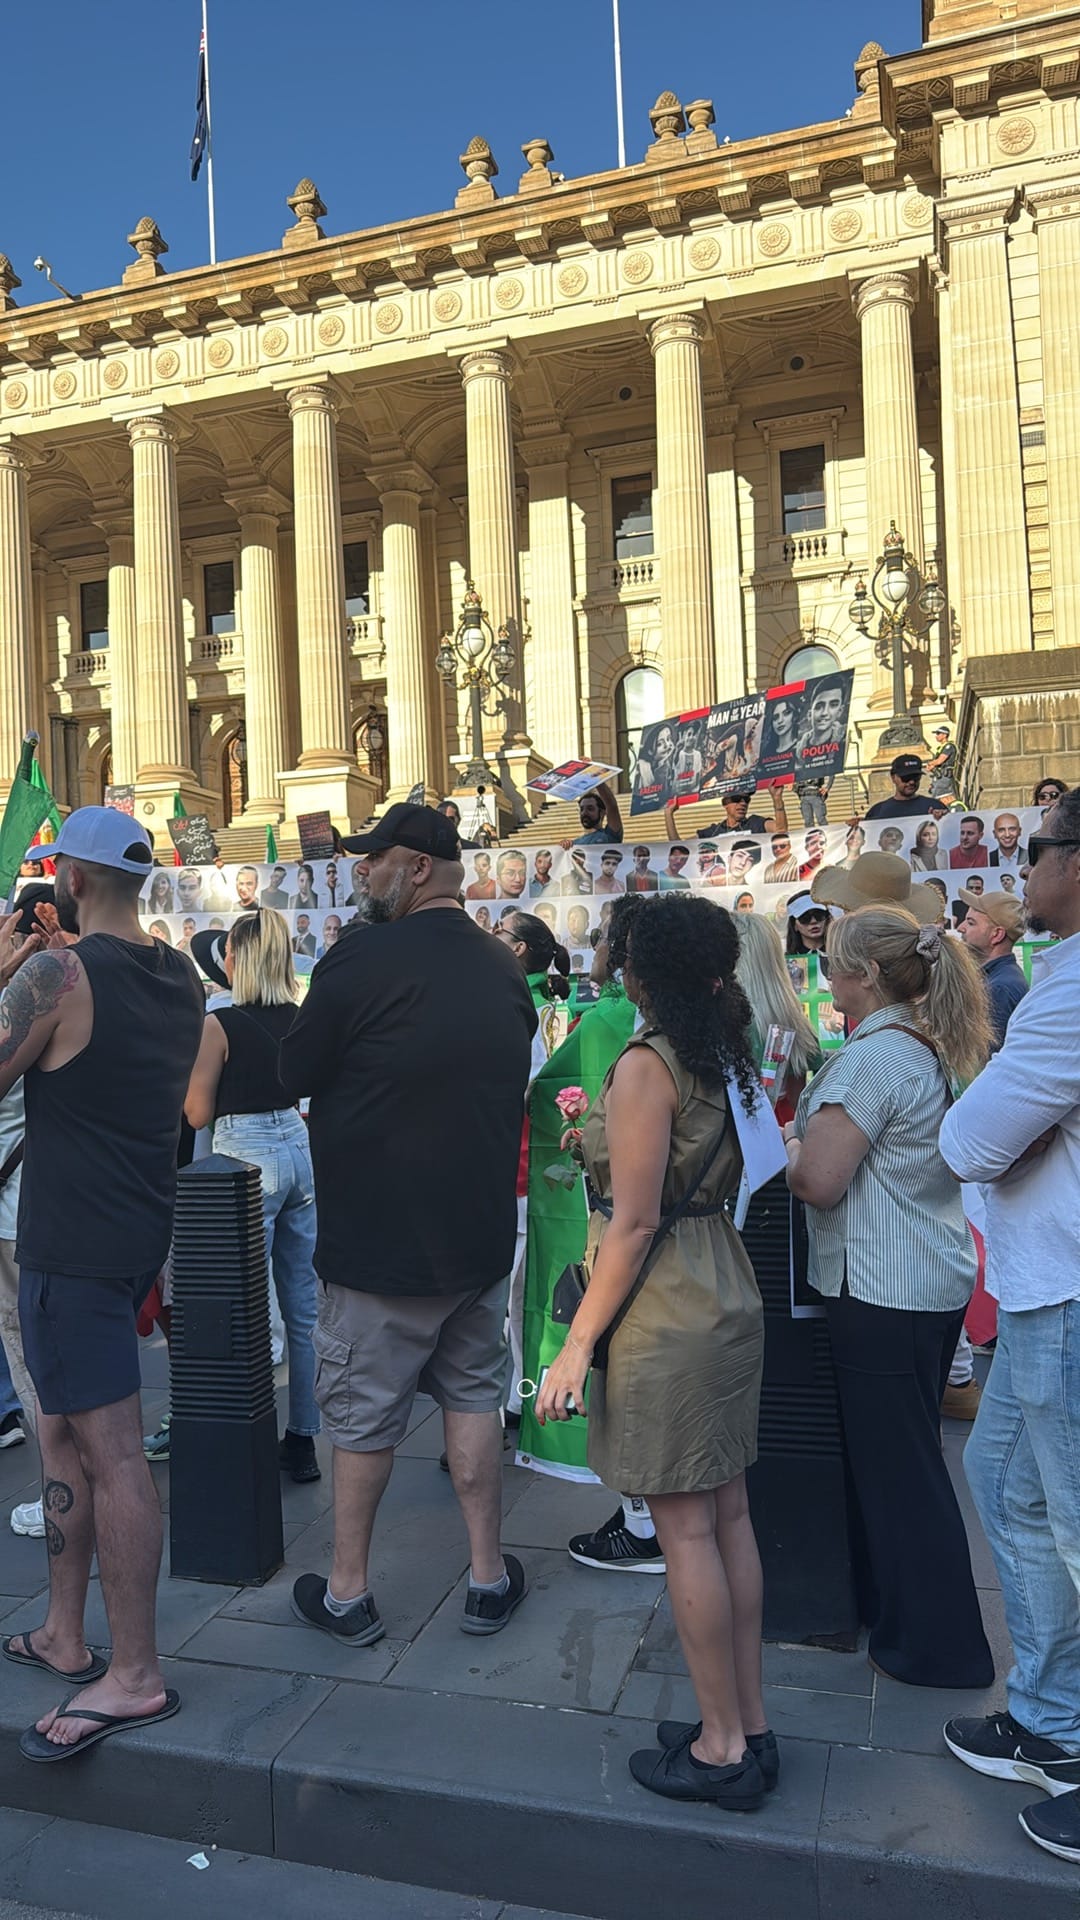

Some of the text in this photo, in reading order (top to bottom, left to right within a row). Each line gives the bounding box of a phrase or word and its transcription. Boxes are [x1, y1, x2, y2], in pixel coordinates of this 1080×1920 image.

[706, 710, 730, 729] MAN
[740, 701, 766, 719] YEAR
[802, 741, 840, 758] POUYA
